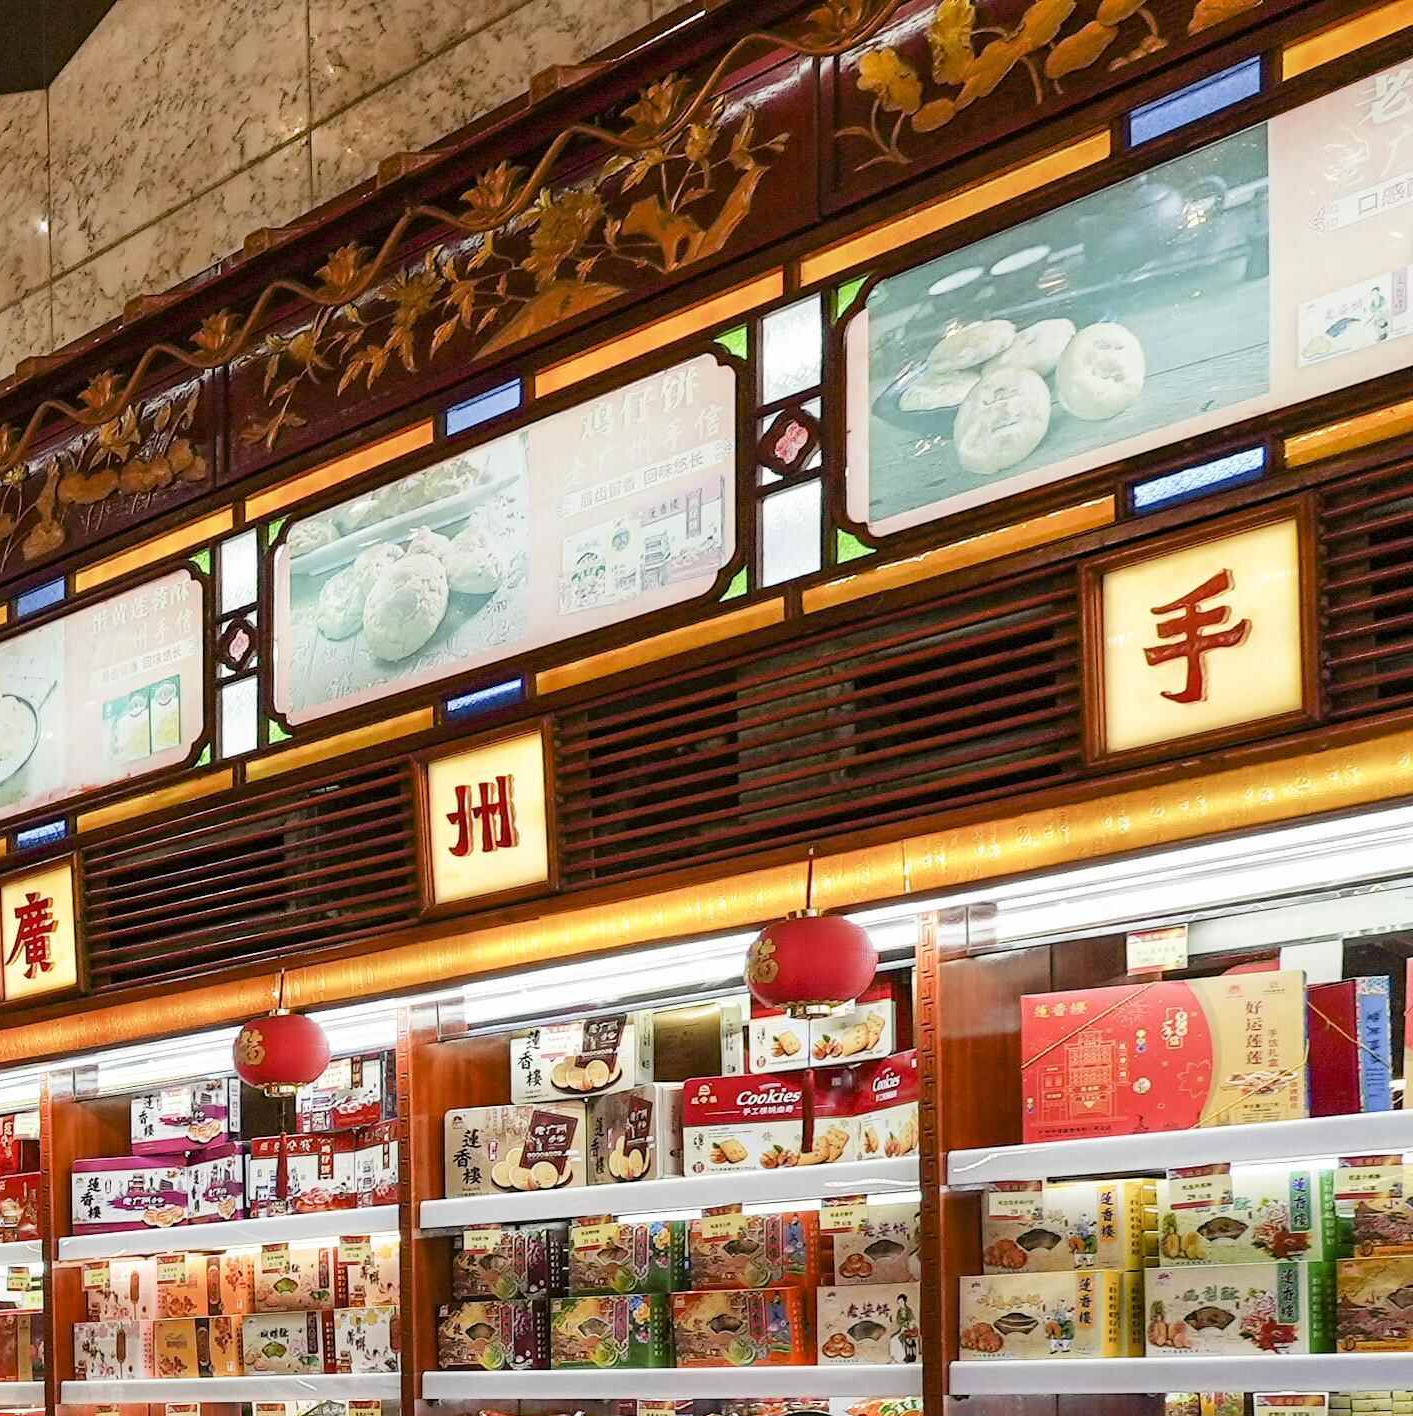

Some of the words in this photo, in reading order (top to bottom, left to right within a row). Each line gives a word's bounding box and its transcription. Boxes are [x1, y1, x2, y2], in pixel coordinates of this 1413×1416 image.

[5, 891, 60, 980] 廣
[447, 773, 519, 857] 州
[1142, 567, 1250, 703] 手
[1245, 1000, 1263, 1066] 好运莲莲
[736, 1088, 802, 1106] Cookies
